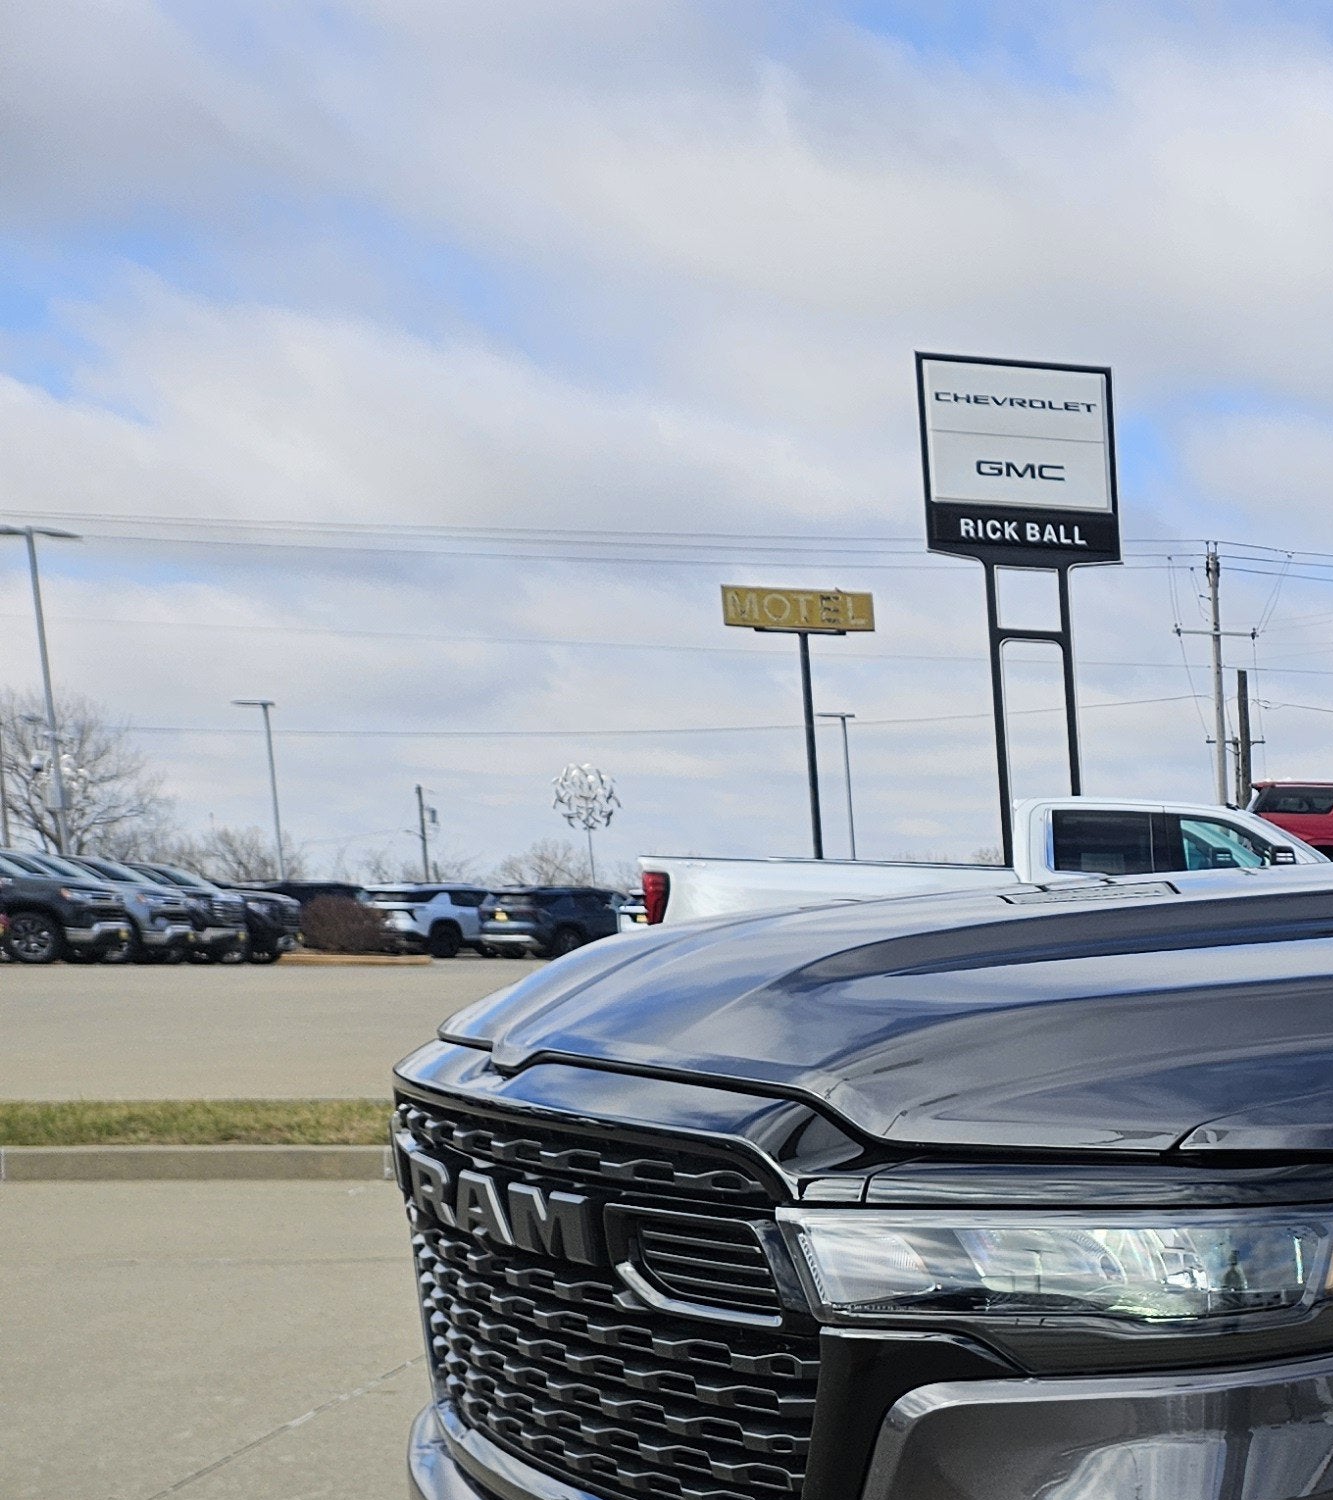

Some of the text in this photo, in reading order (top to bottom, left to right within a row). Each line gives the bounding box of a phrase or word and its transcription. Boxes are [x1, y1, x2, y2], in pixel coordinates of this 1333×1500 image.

[934, 391, 1097, 413] CHEVROLET
[975, 459, 1066, 481] GMC
[959, 517, 1088, 546] RICK BALL
[726, 590, 870, 626] MOTEL
[408, 1149, 598, 1267] RAM
